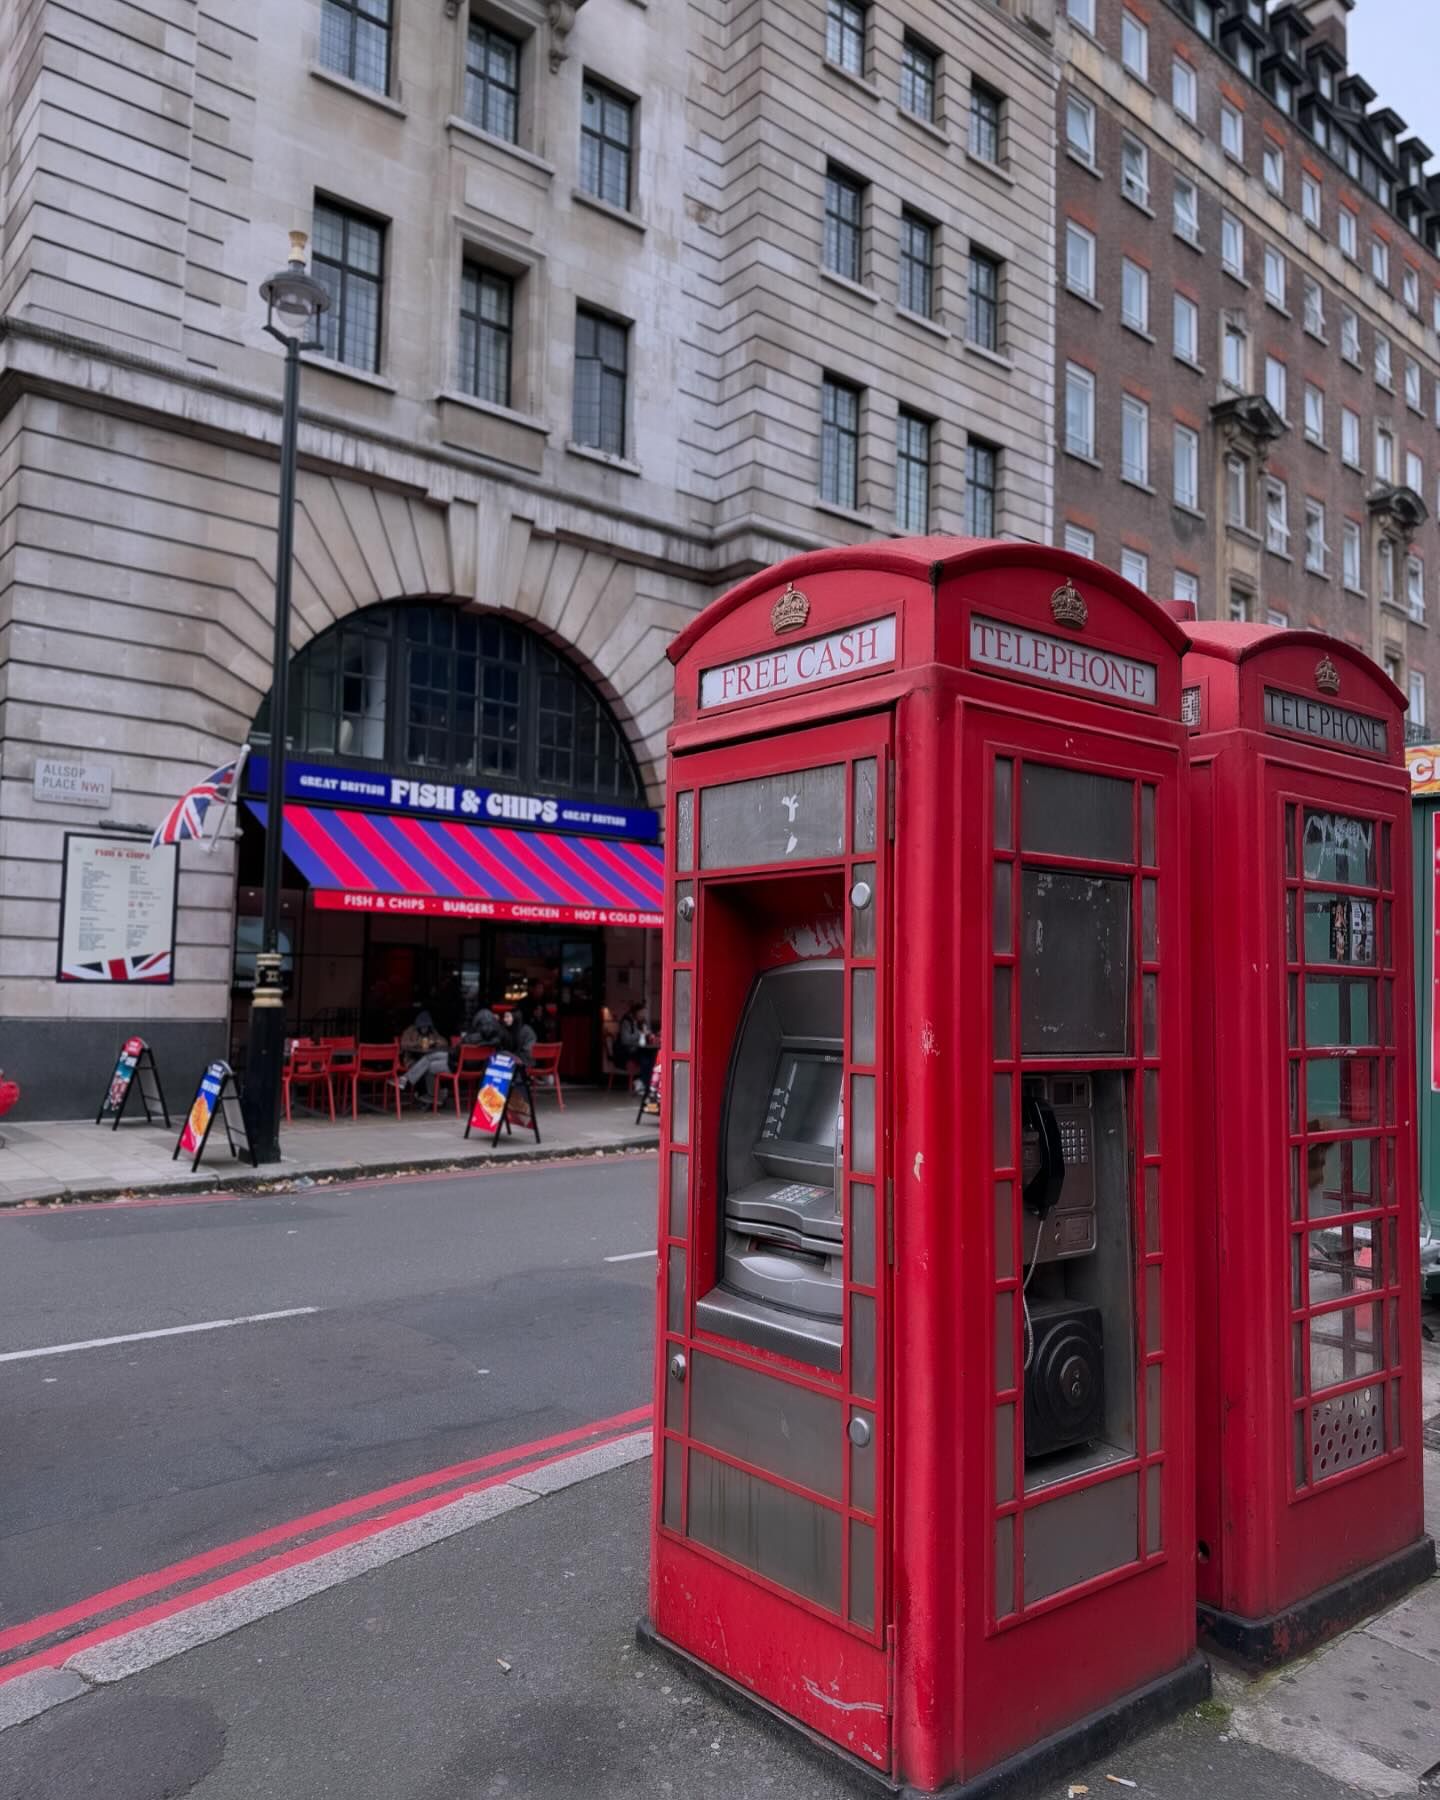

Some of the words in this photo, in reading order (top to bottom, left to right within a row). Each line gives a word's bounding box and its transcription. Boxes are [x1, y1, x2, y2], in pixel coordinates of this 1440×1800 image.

[722, 653, 789, 699] FREE
[796, 626, 880, 679] CASH
[973, 623, 1146, 698] TELEPHONE
[1266, 692, 1382, 750] TELEPHONE
[42, 776, 77, 791] PLACE
[81, 781, 105, 793] NW1
[43, 763, 87, 779] ALLSOP
[300, 775, 338, 790] GREAT
[340, 780, 386, 797] BRITISH
[390, 778, 456, 811] FISH
[460, 789, 482, 814] &
[486, 793, 559, 823] CHIPS
[562, 810, 591, 822] GREAT
[592, 813, 627, 828] BRITISH
[344, 894, 373, 907] FISH
[376, 896, 385, 908] &
[389, 897, 425, 910] CHIPS
[443, 900, 495, 915] BURGERS
[512, 905, 560, 918] CHICKEN
[574, 909, 597, 921] HOT
[599, 911, 607, 922] &
[609, 911, 637, 923] COLD
[638, 913, 665, 925] DRIN
